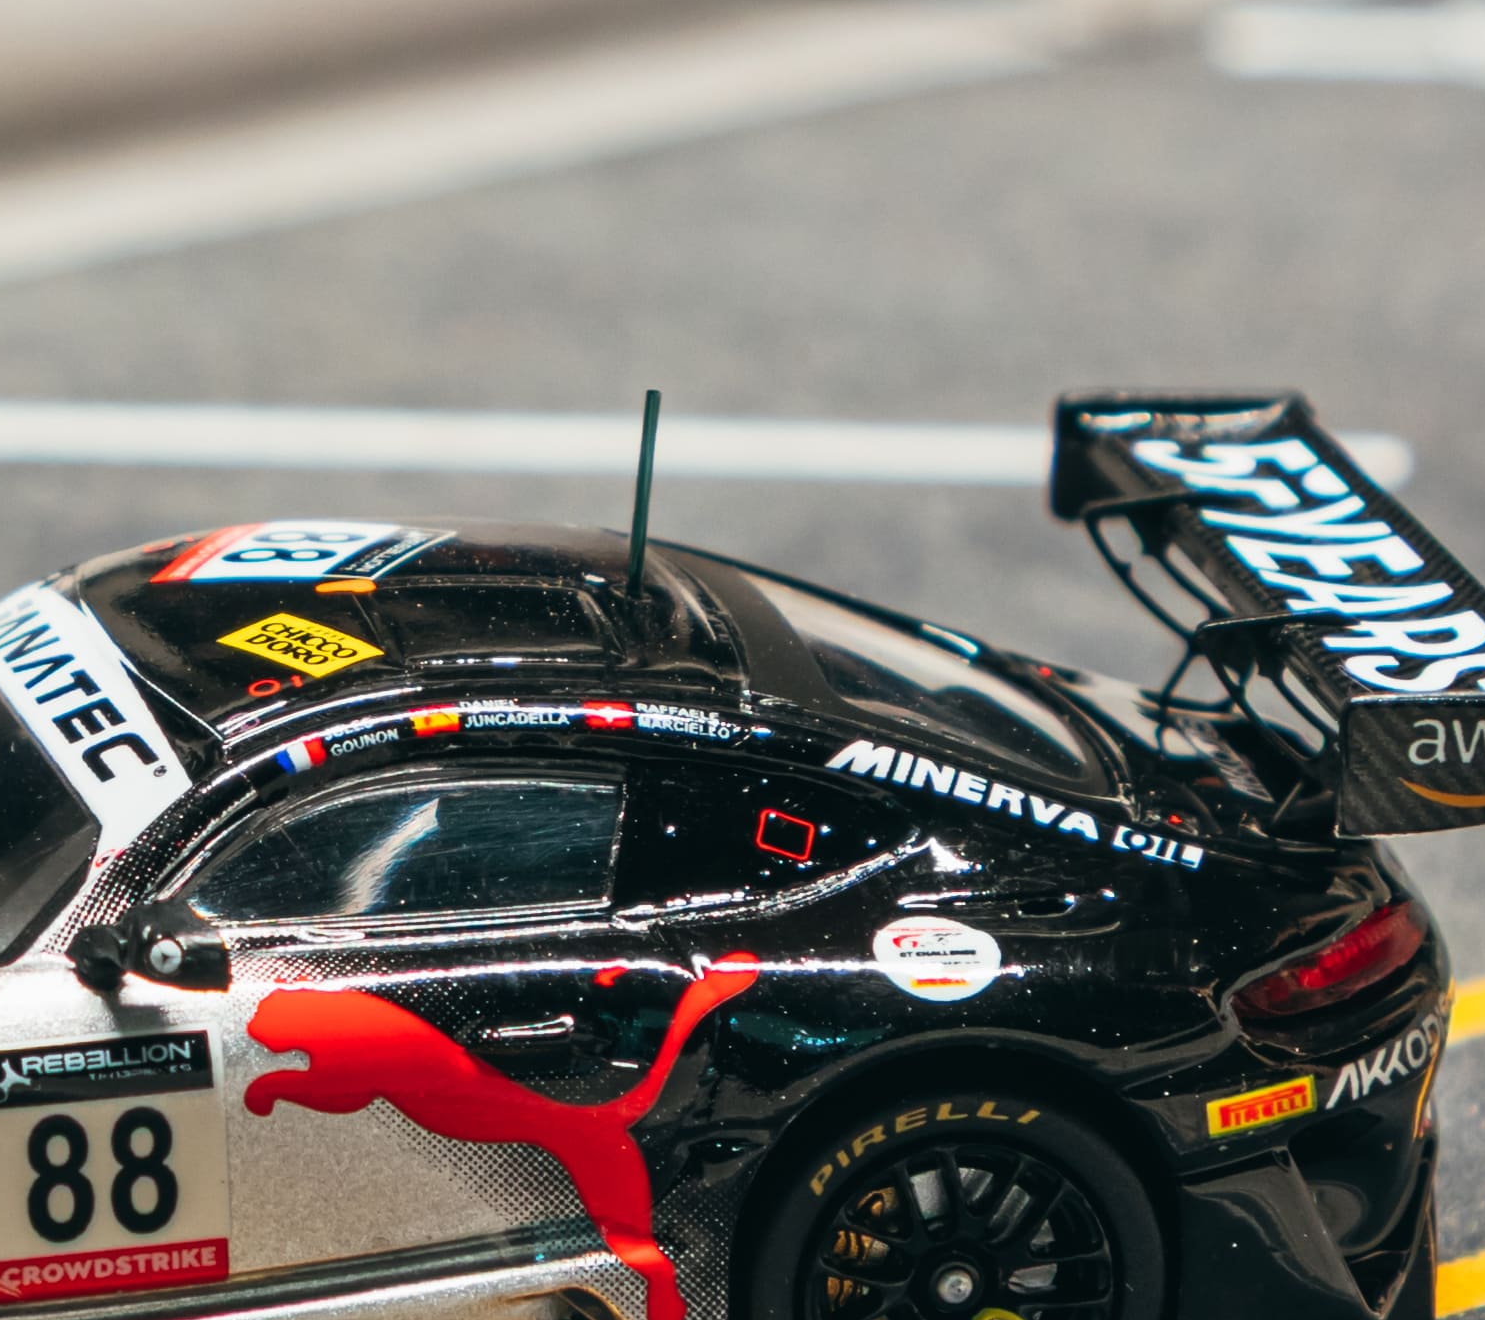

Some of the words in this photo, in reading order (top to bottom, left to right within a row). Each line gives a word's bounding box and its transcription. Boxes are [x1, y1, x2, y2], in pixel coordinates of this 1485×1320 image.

[261, 622, 358, 659] CHICCO
[464, 711, 571, 729] JUNCADELLA
[330, 728, 400, 757] GOUNON
[825, 739, 1100, 841] MINERVA
[21, 1040, 193, 1076] REBELLION
[1218, 1083, 1309, 1129] PIRELLI
[808, 1101, 1042, 1197] PIRELLI
[27, 1106, 180, 1243] 88
[0, 1246, 218, 1290] CROWDSTRIKE
